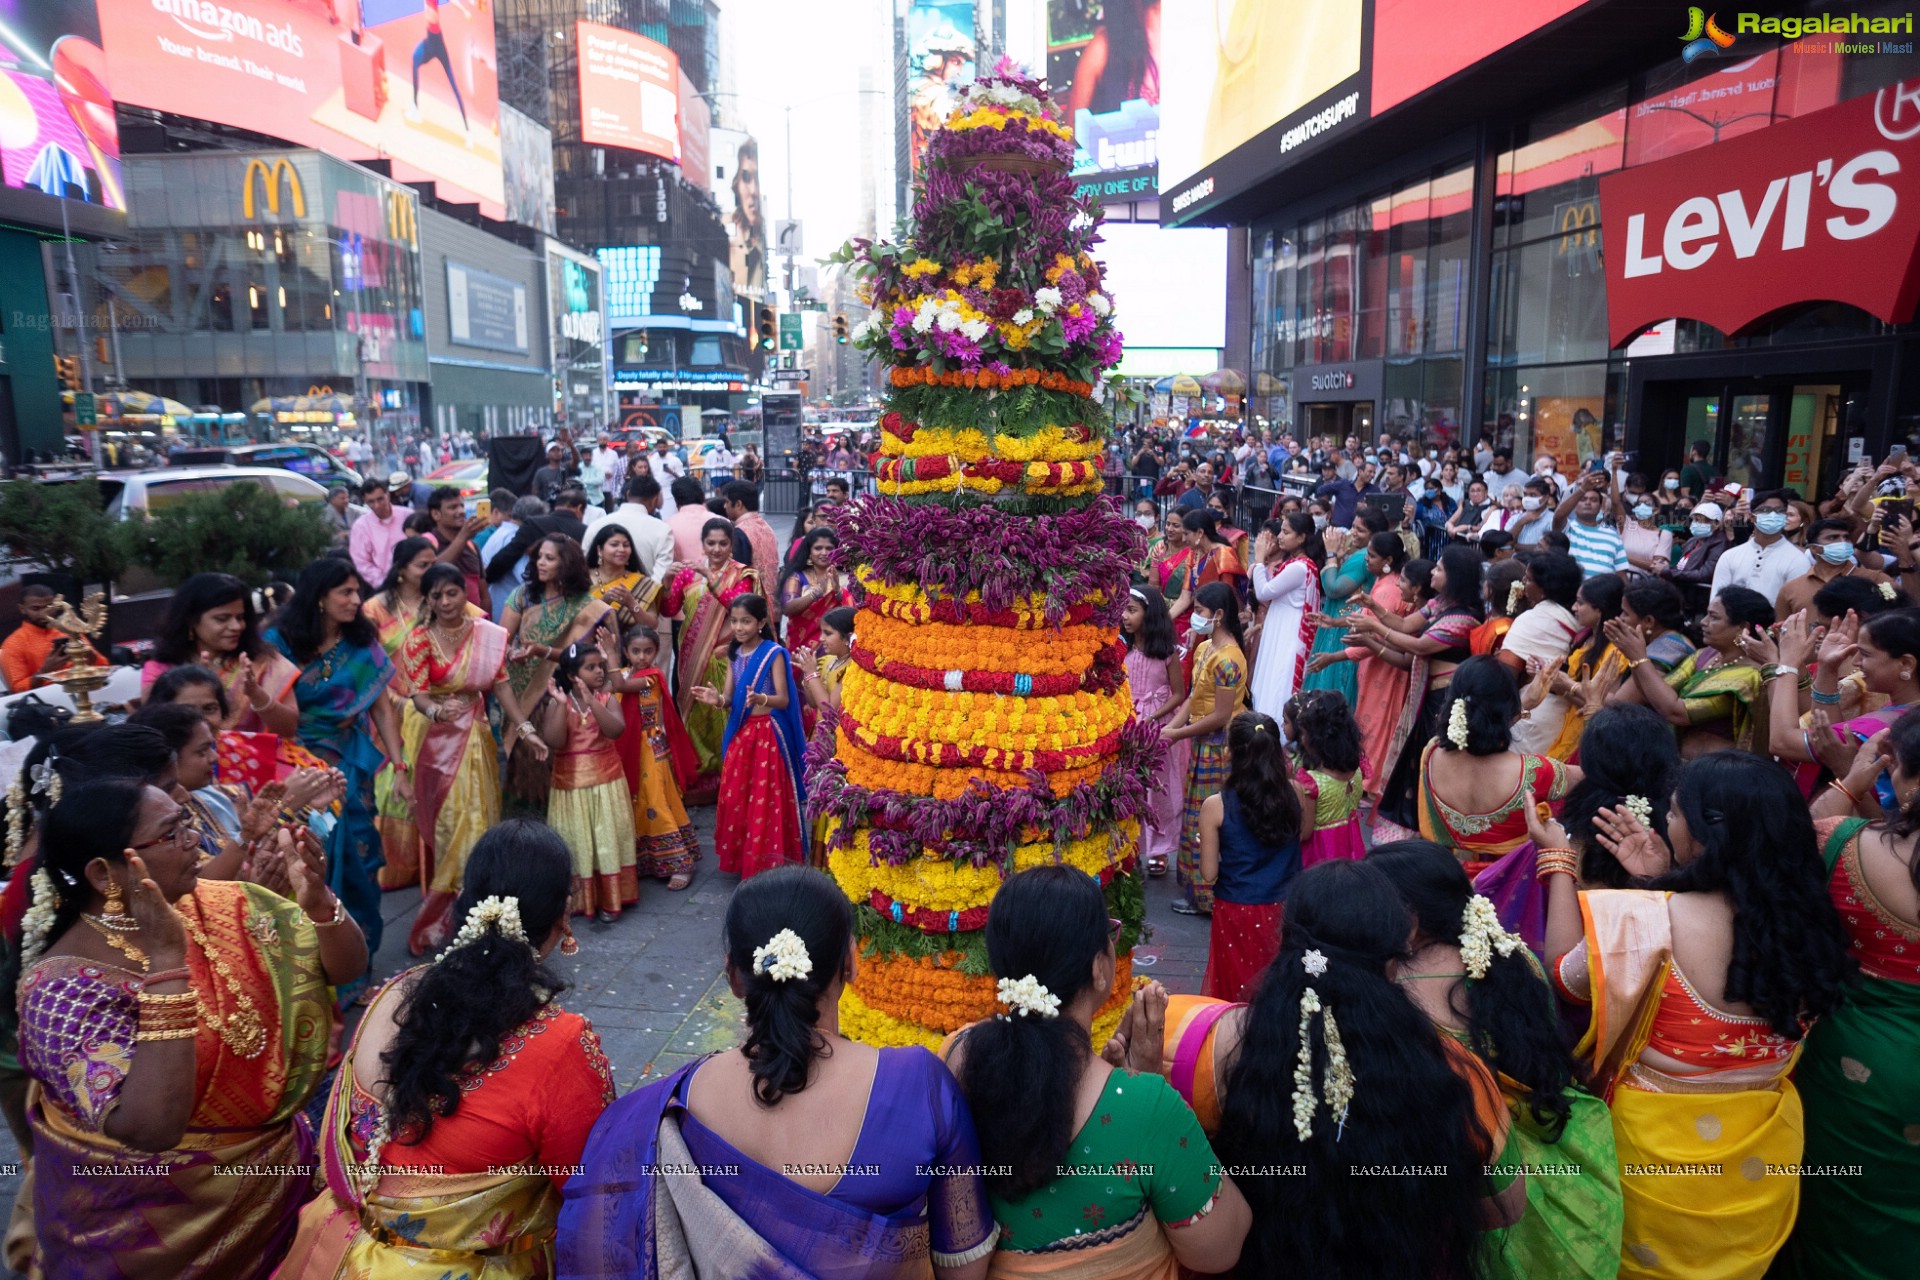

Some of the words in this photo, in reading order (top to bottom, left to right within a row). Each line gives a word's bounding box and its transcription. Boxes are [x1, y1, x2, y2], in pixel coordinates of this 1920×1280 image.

[157, 35, 194, 58] Your
[265, 22, 304, 58] ads
[1104, 180, 1130, 195] ONE
[1132, 176, 1150, 192] OF
[1311, 370, 1346, 390] swatch
